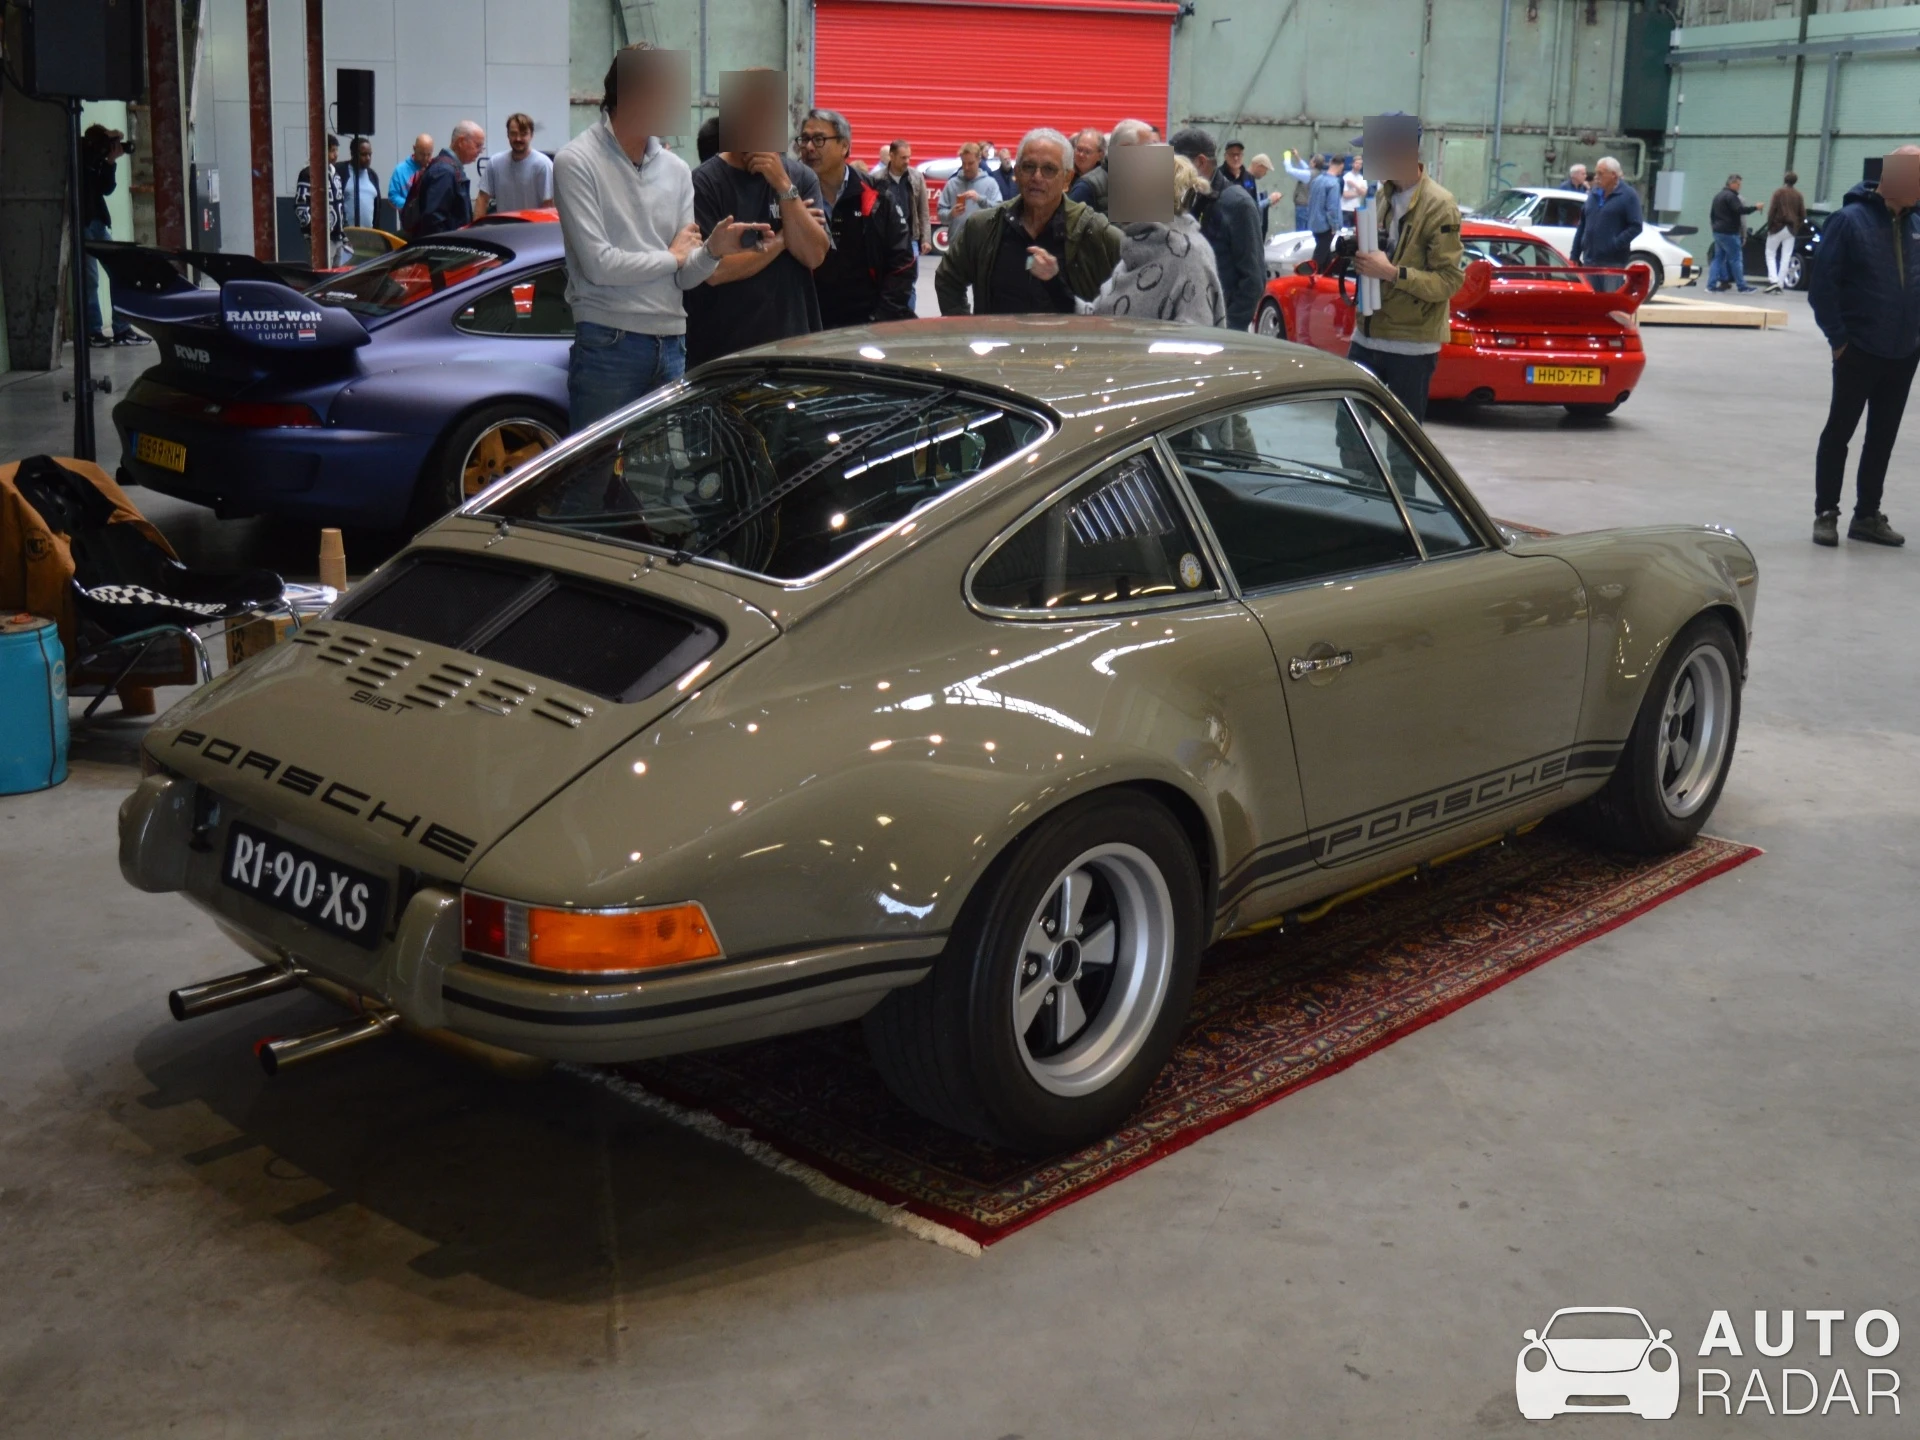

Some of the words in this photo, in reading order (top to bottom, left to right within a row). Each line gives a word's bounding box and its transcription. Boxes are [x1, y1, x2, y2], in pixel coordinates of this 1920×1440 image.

[226, 311, 322, 322] RAUH-Welt
[233, 322, 317, 330] HEADQUARTERS
[258, 332, 295, 341] EUROPE
[174, 344, 211, 364] RWB
[1538, 369, 1595, 383] HHD-71-F
[171, 729, 478, 864] PORSCHE
[1327, 756, 1566, 854] PORSCHE
[231, 833, 369, 932] R1-90-XS
